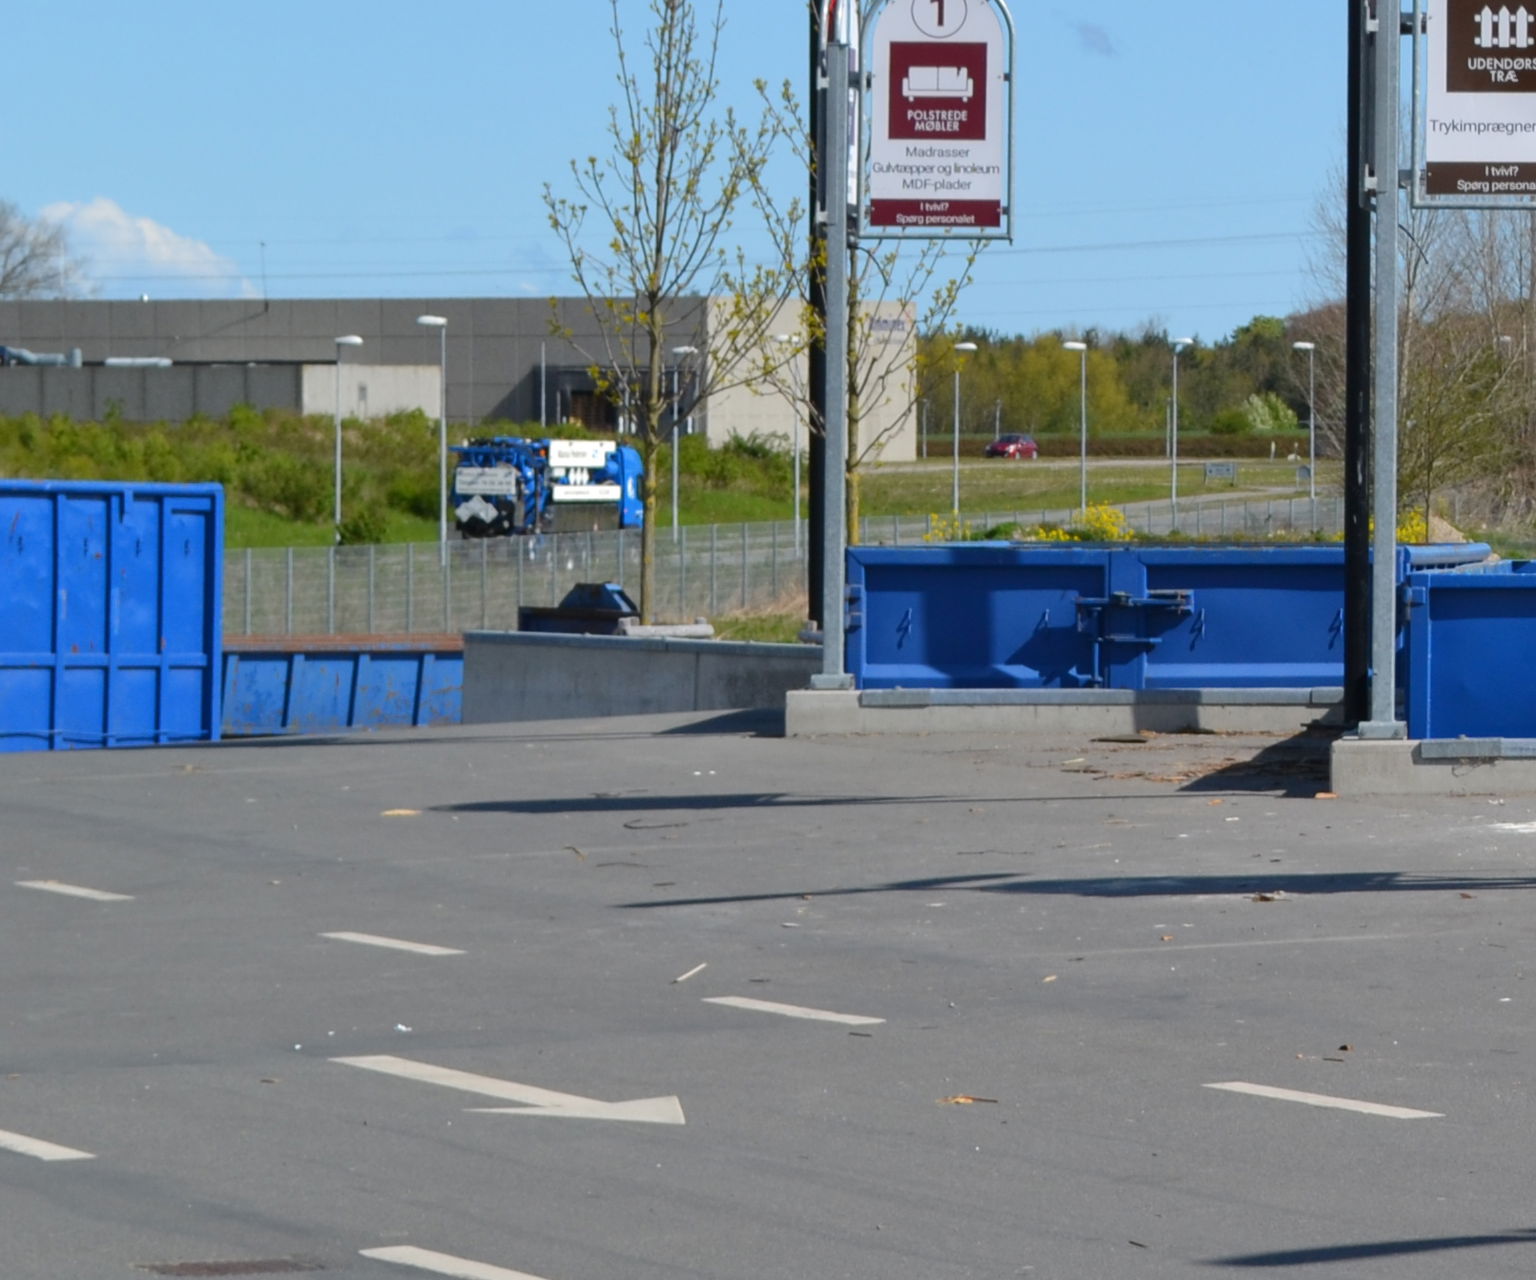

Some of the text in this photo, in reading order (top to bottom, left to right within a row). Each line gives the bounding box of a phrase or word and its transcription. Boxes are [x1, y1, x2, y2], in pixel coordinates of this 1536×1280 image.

[1489, 70, 1519, 83] TRÆ
[907, 109, 968, 121] POLSTREDE
[914, 121, 960, 132] MØBLER
[905, 146, 970, 158] Madrasser
[937, 165, 952, 176] og
[954, 163, 1000, 175] linoleum
[1485, 166, 1519, 177] I tvivl?
[902, 179, 972, 192] MDF-plader
[1456, 179, 1490, 192] Spørg
